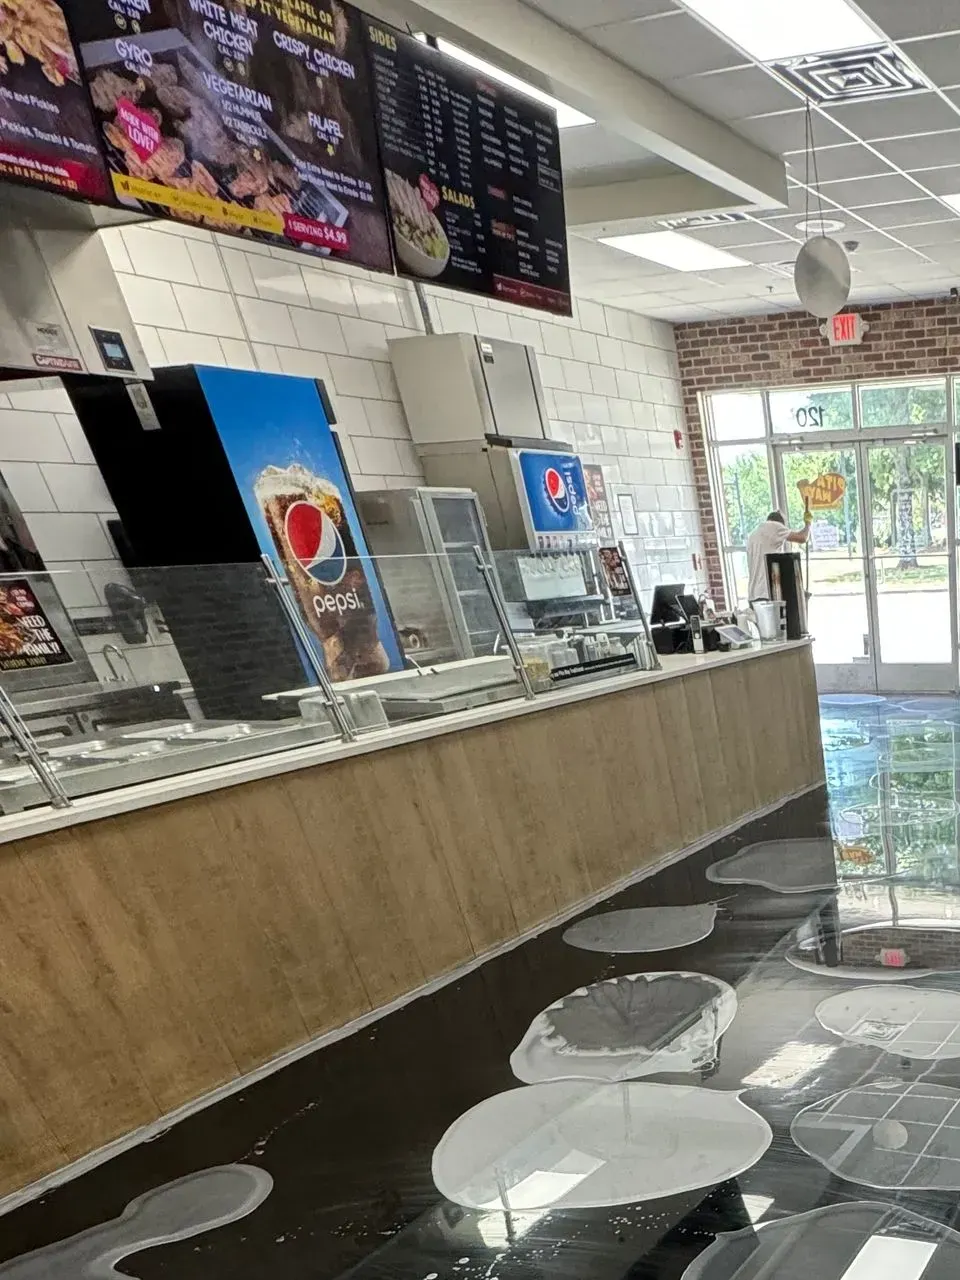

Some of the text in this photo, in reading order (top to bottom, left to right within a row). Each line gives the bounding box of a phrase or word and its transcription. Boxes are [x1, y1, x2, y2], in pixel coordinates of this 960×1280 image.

[189, 0, 259, 38] WHITE MEAT
[274, 6, 336, 46] VEGETARIAN
[320, 10, 333, 27] OR
[203, 20, 254, 57] CHICKEN
[368, 26, 398, 53] SIDES
[115, 38, 153, 68] GYRO
[273, 30, 356, 80] CRISPY CHICKEN
[202, 71, 273, 112] VEGETARIAN
[307, 111, 345, 139] FALAFEL
[441, 185, 476, 210] SALADS
[293, 221, 324, 238] SERVING
[324, 227, 347, 244] $4.99
[832, 315, 856, 342] EXIT
[313, 588, 360, 618] pepsi
[21, 615, 46, 628] FEED
[31, 628, 54, 641] THE
